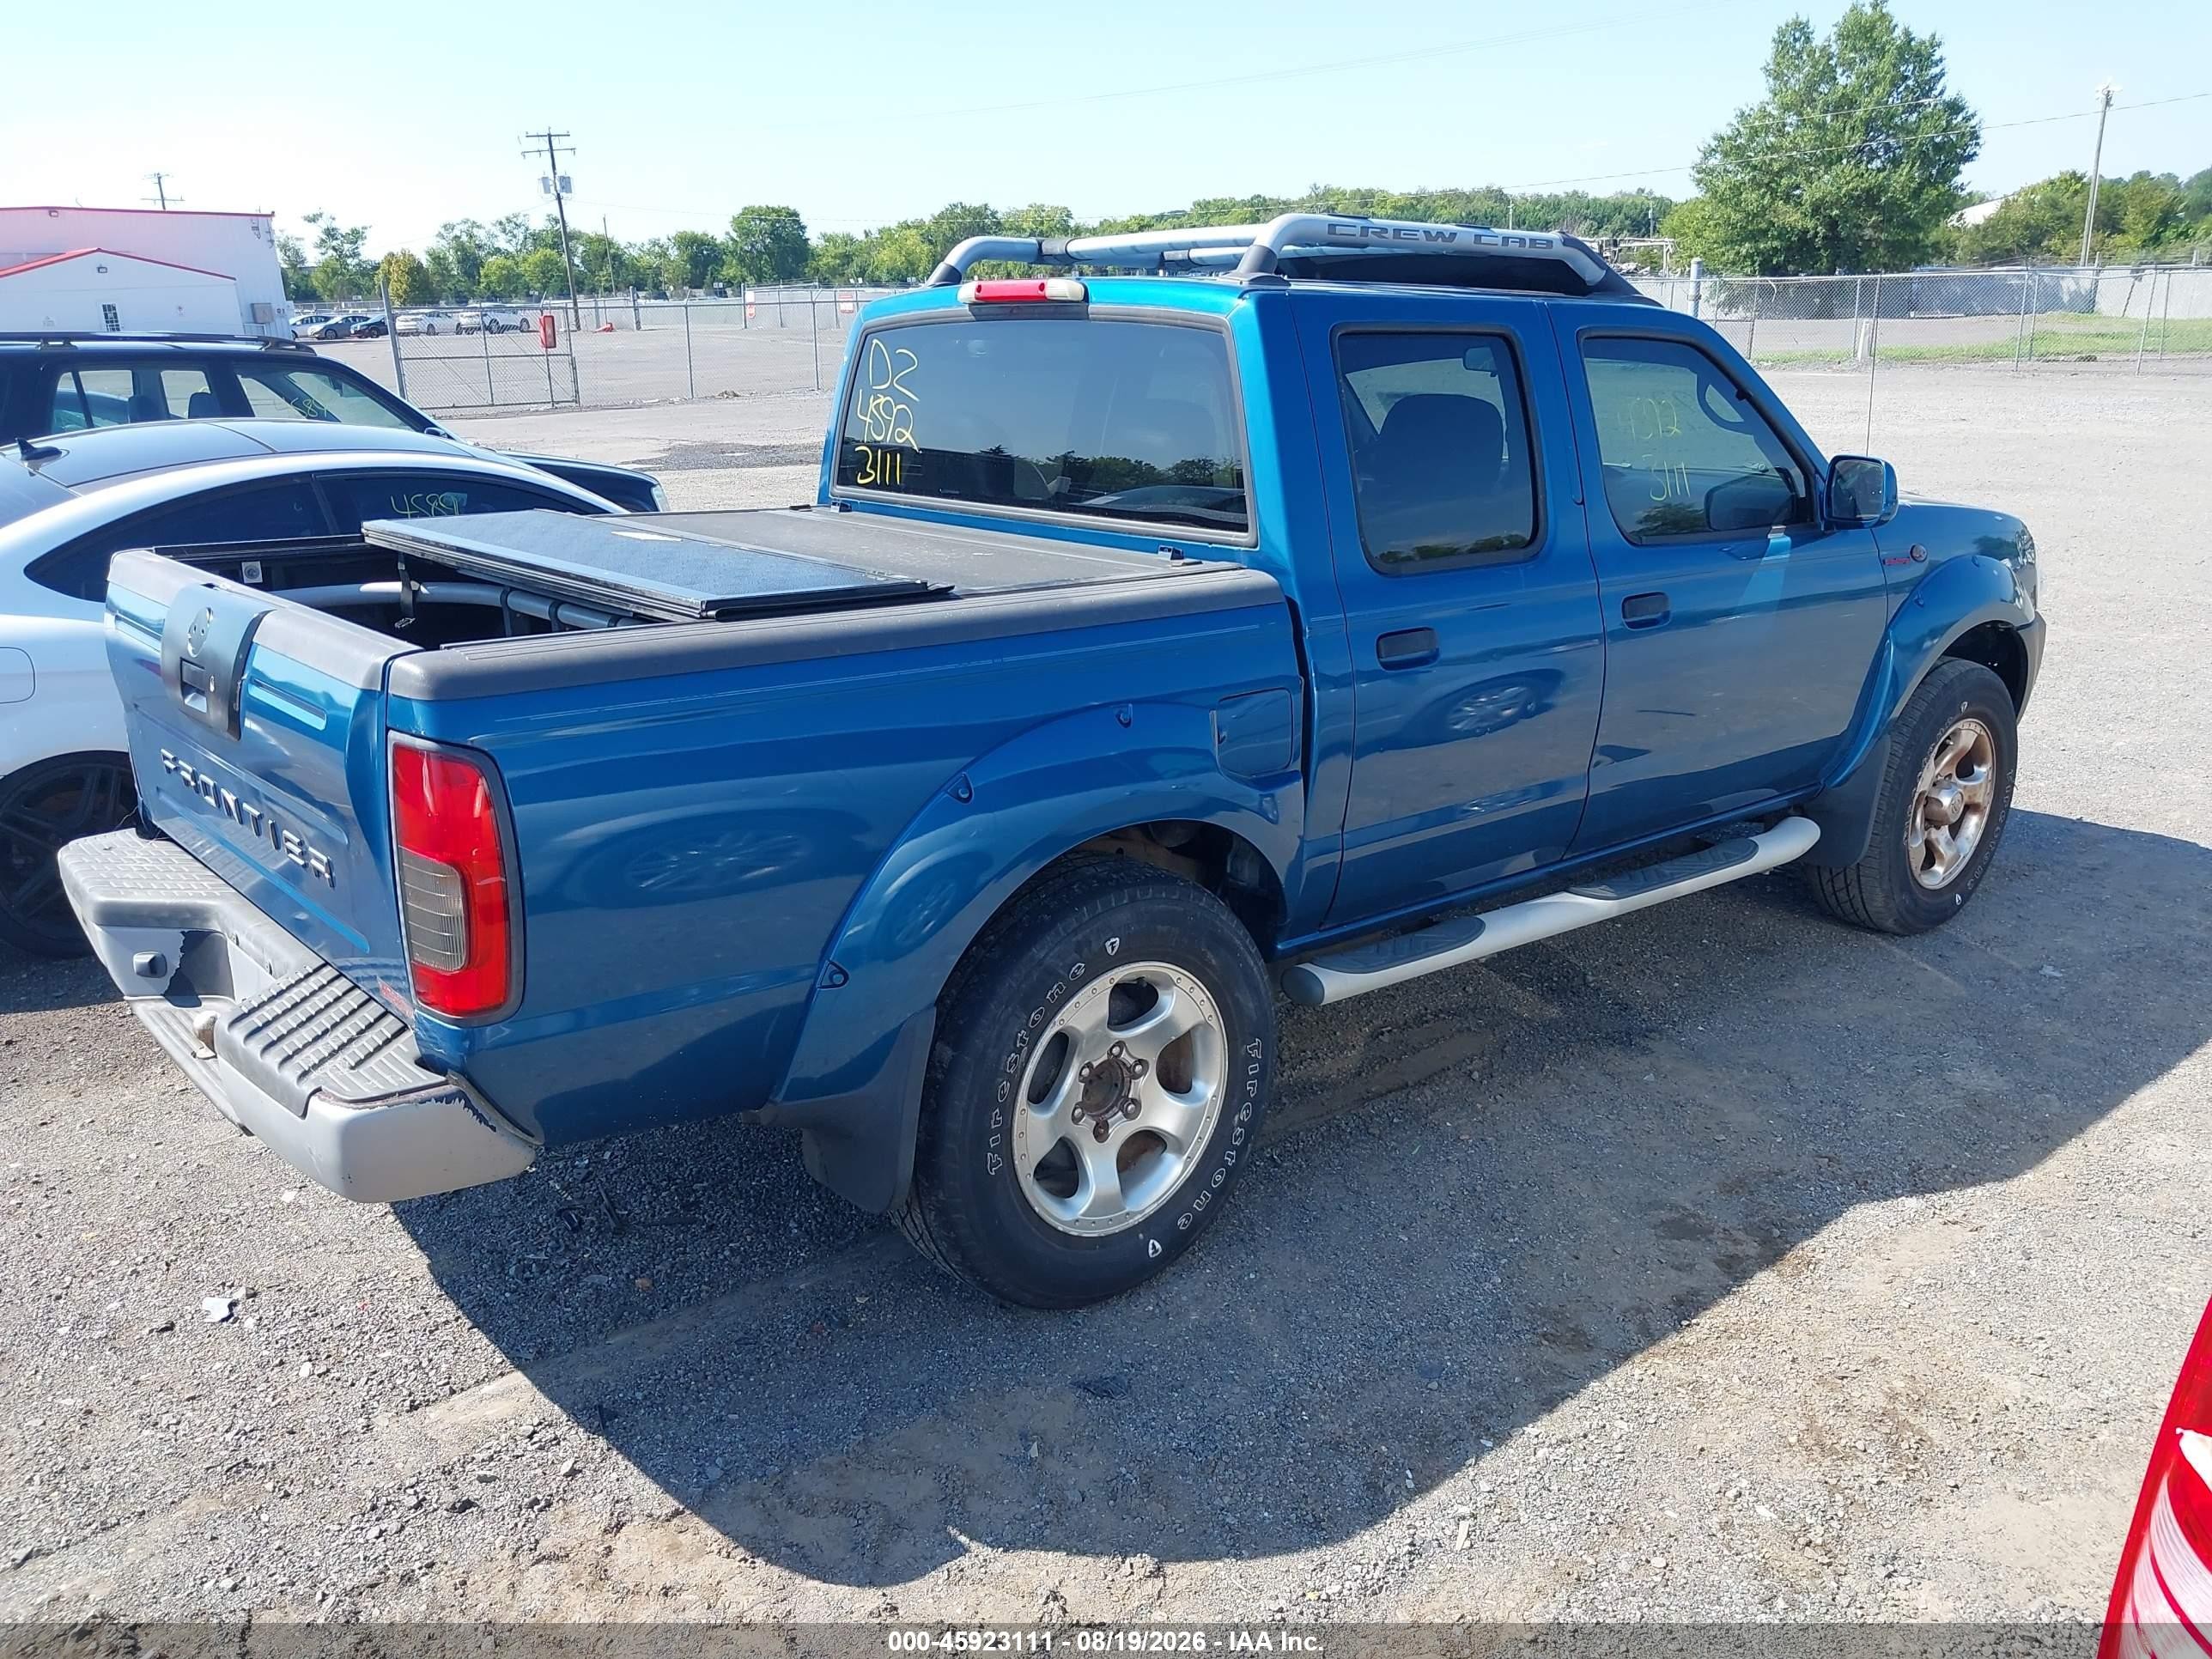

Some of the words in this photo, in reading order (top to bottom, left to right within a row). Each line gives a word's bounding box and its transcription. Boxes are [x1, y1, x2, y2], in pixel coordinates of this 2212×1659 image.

[1327, 222, 1458, 244] CREW
[1473, 234, 1554, 250] CAB
[869, 338, 921, 403] D2
[857, 388, 923, 454] 4592
[854, 445, 902, 486] 3111
[160, 747, 337, 890] FRONTIER
[988, 963, 1085, 1176] Firestone
[1177, 1037, 1262, 1230] Firestone
